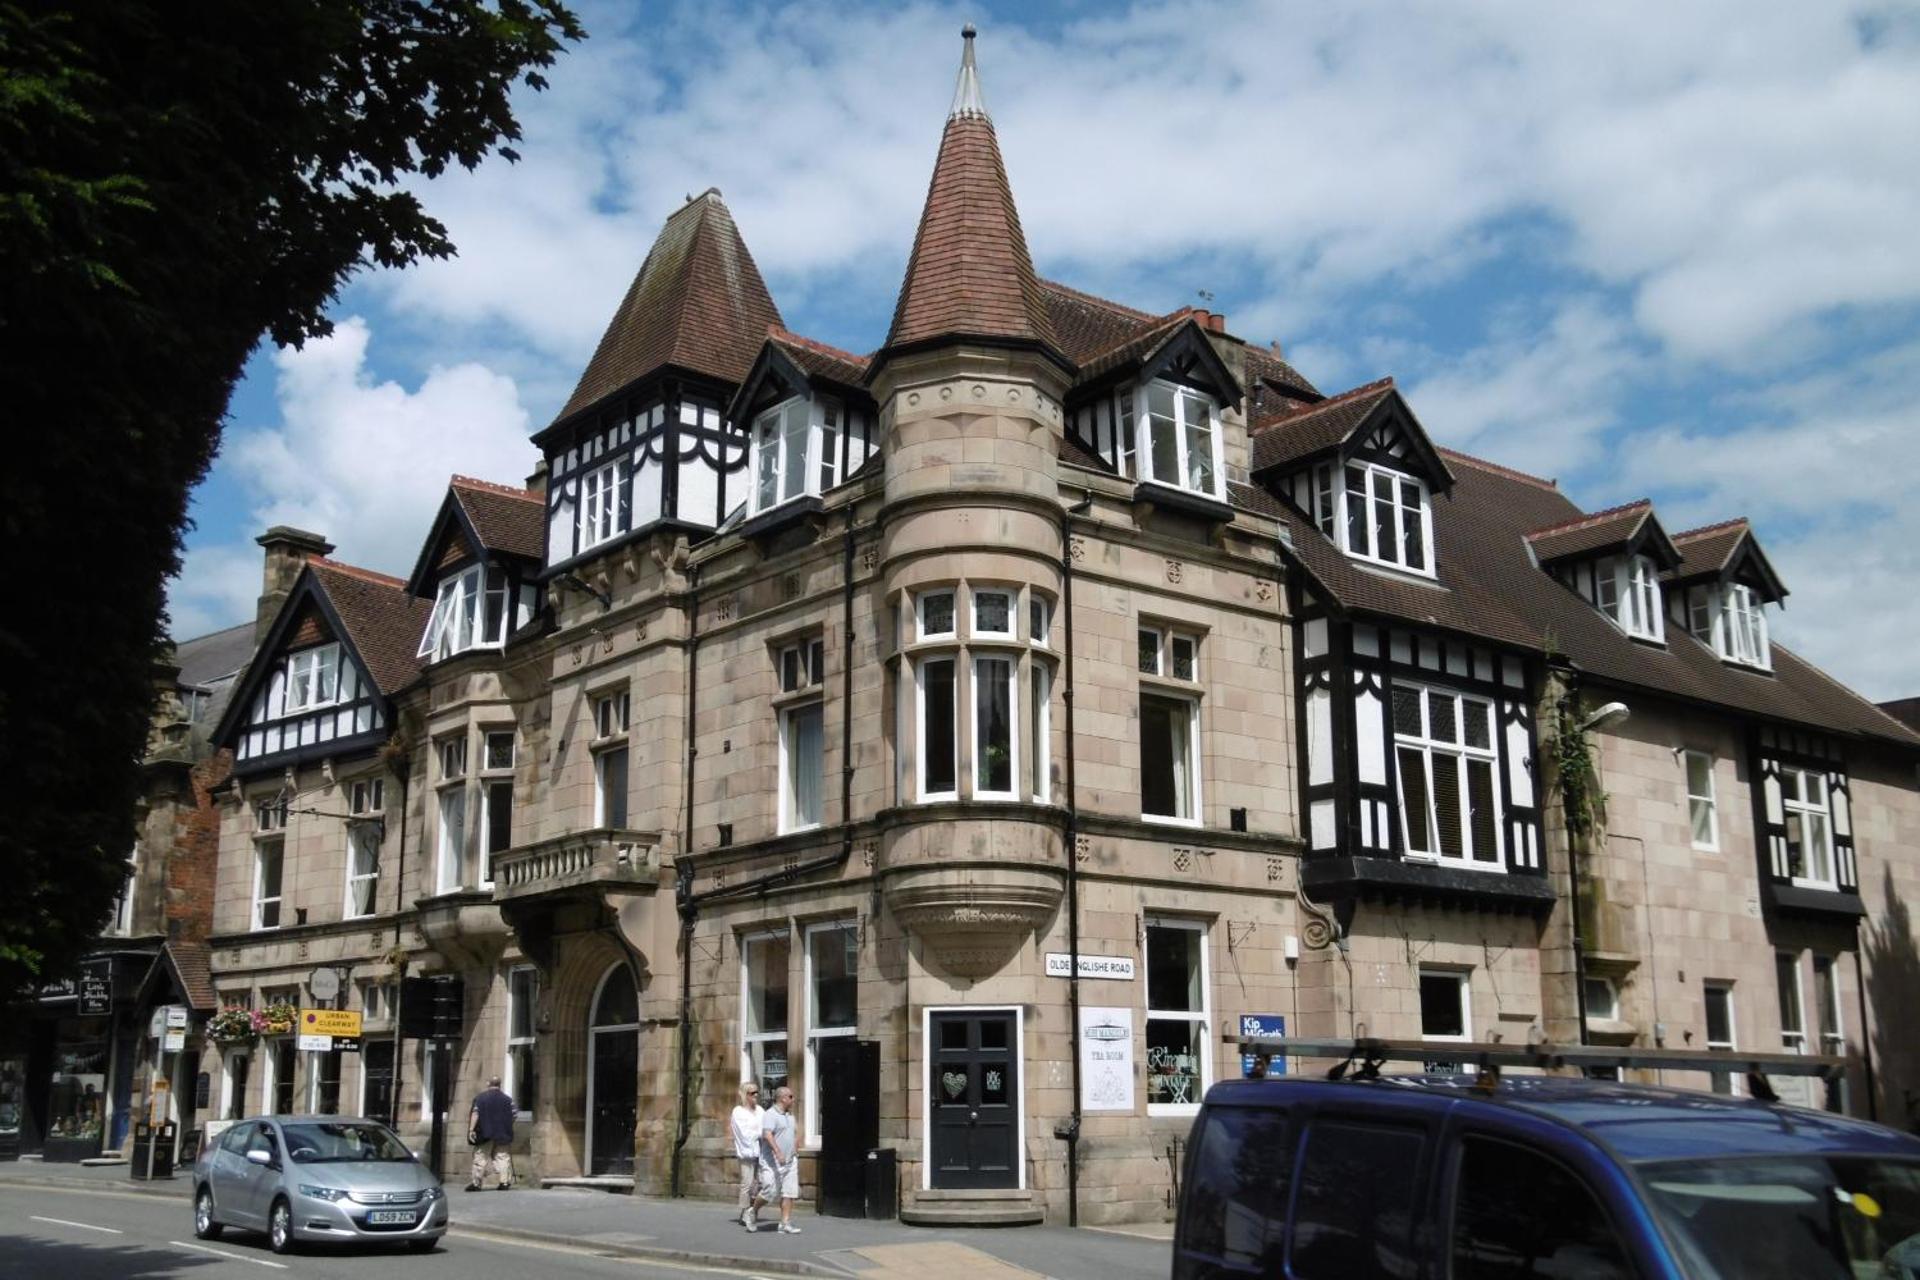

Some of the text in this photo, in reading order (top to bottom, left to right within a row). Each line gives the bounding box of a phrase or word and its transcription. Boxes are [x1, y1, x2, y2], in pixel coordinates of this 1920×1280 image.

[1050, 959, 1131, 973] OLDE NGLISHE ROAD
[318, 1020, 356, 1028] CLEARWAY
[1243, 1017, 1260, 1032] Kip
